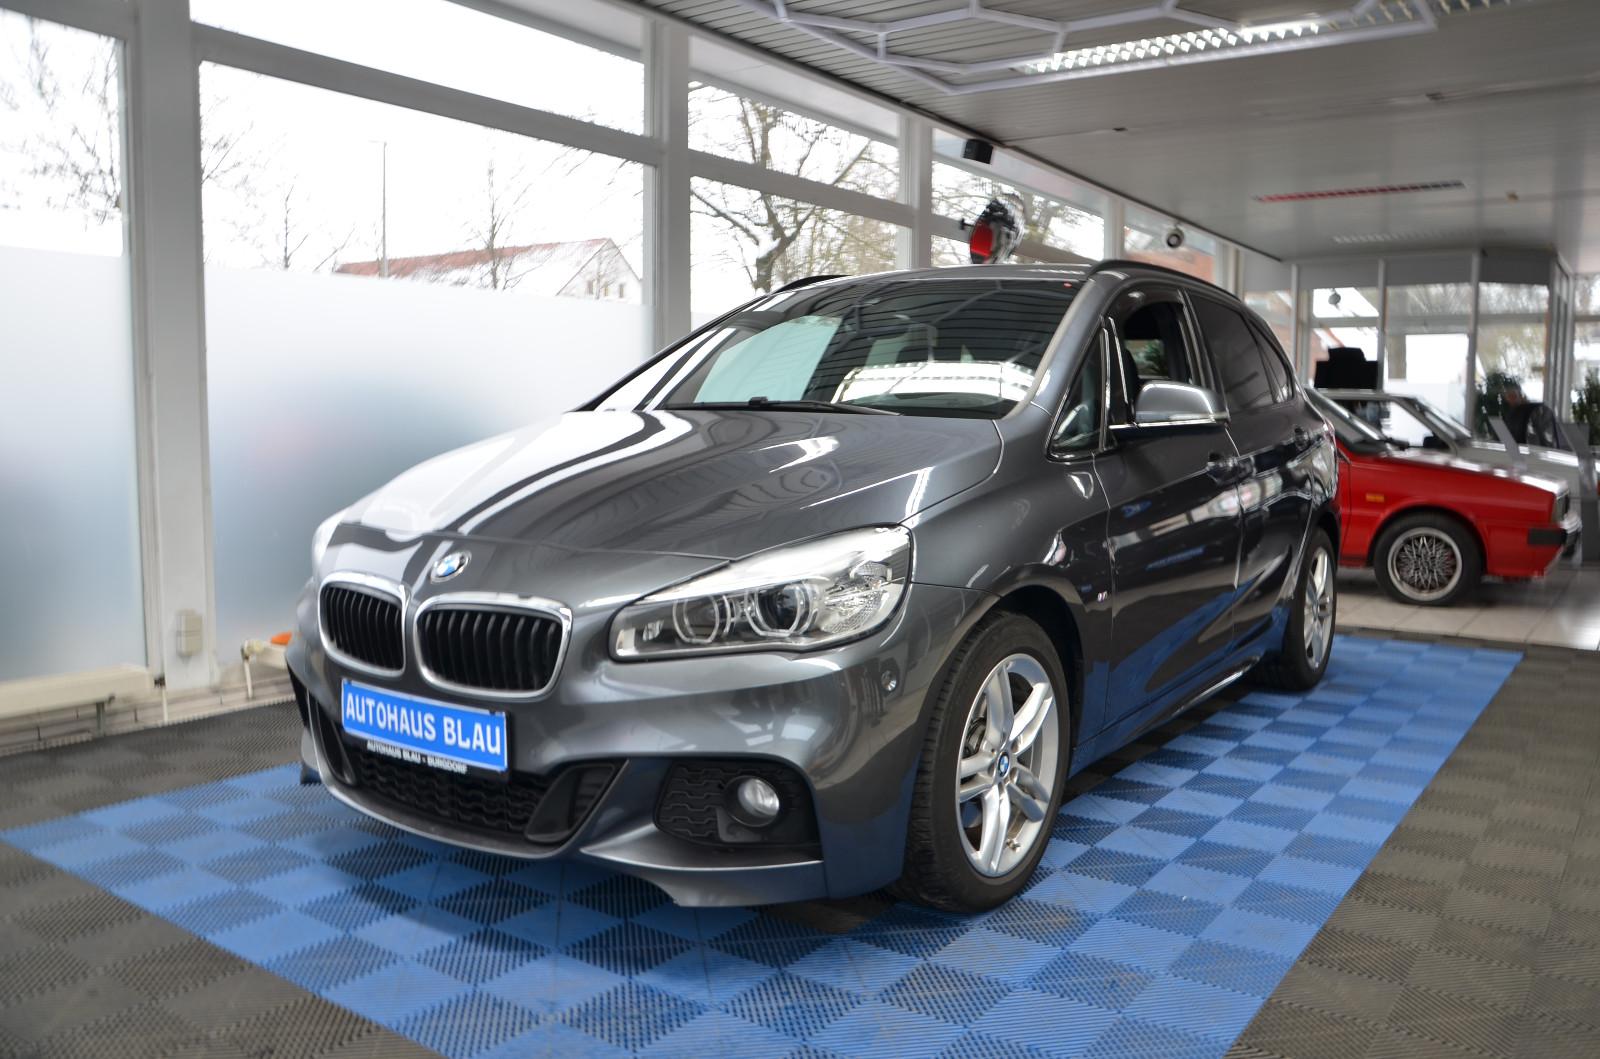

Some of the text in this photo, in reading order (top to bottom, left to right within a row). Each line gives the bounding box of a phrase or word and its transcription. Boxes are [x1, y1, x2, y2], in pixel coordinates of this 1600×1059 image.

[346, 692, 501, 756] AUTOHAUS BLAU
[366, 739, 402, 759] AUTOHAUS
[402, 748, 421, 764] BLAU
